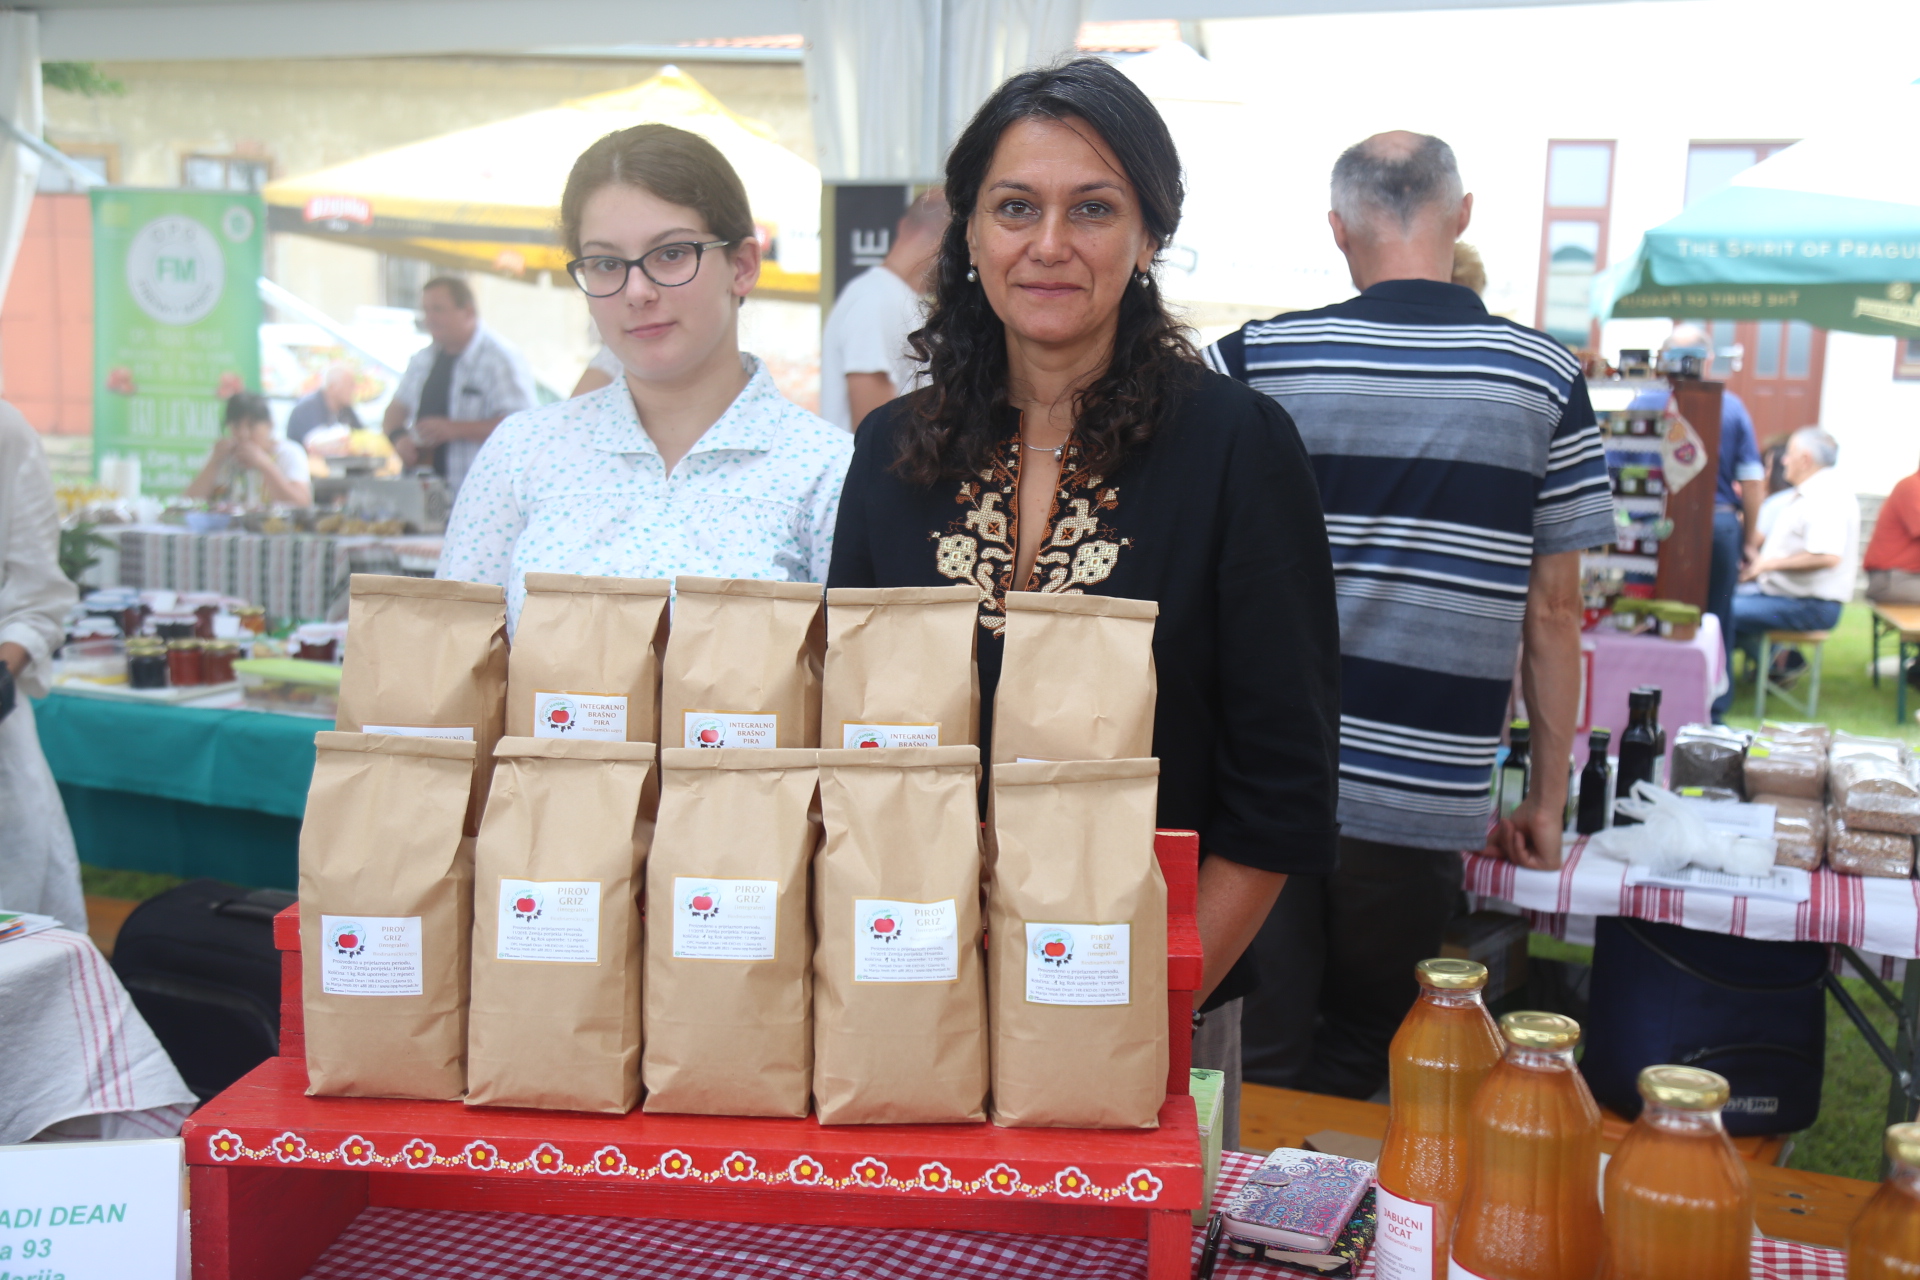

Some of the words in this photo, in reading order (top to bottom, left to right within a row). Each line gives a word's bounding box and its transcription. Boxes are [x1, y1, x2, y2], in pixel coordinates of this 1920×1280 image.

[1676, 238, 1719, 258] THE
[1725, 238, 1796, 258] SPIRIT
[1800, 240, 1831, 258] OF
[156, 257, 196, 283] FM
[559, 897, 583, 905] GRIZ
[914, 907, 945, 917] PIROV
[916, 918, 940, 926] GRIZ
[49, 1203, 127, 1227] DEAN
[1384, 1207, 1422, 1231] JABUČNI
[1388, 1223, 1412, 1240] OCAT
[22, 1238, 52, 1259] 93
